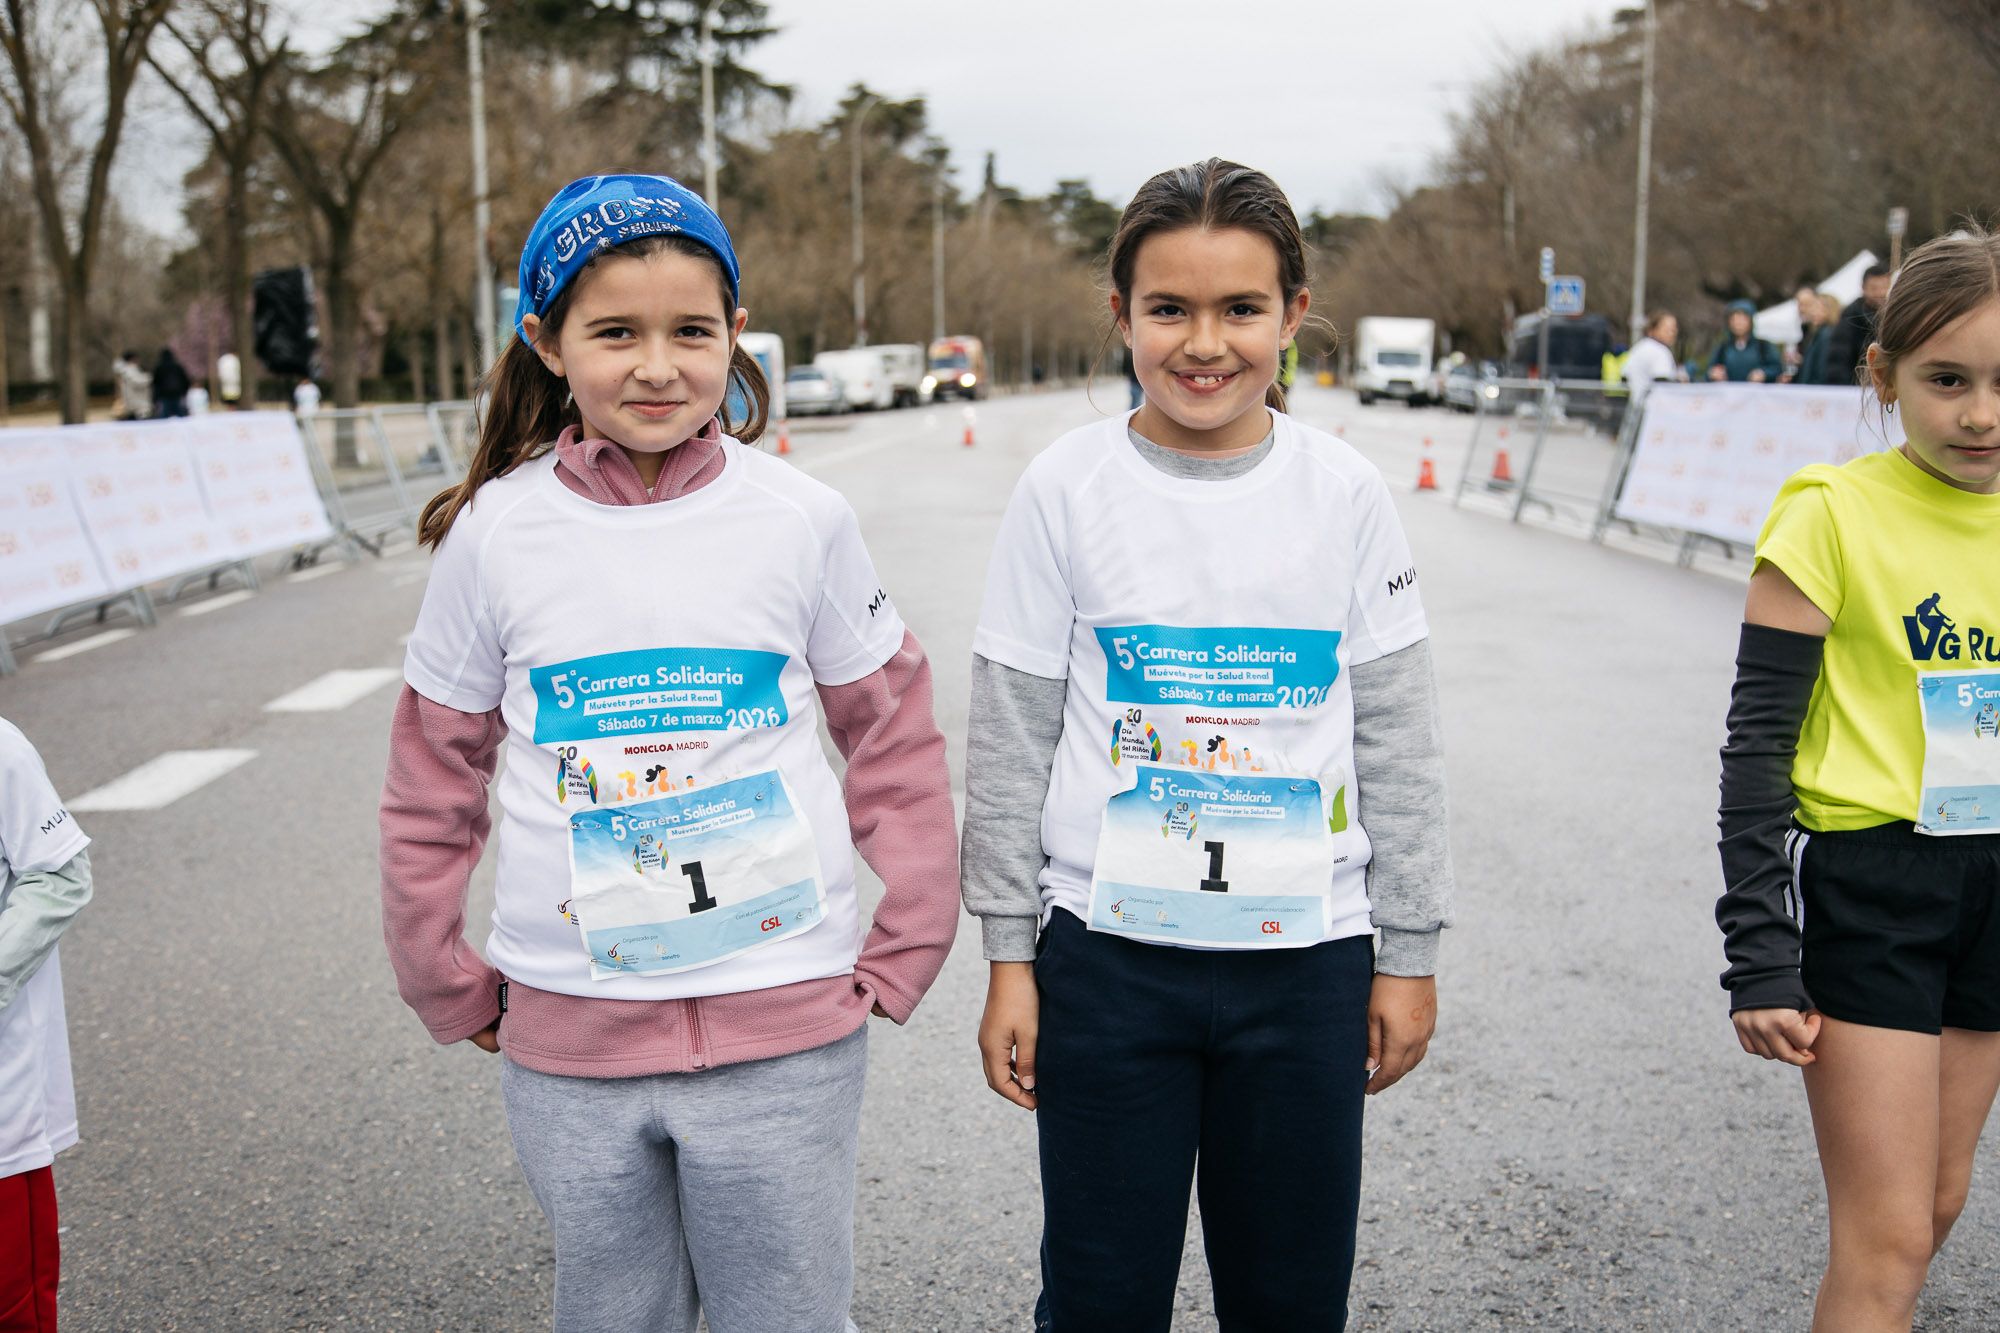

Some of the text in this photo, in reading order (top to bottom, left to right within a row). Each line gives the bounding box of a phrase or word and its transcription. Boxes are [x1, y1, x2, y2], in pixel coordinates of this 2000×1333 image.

[1136, 642, 1208, 664] Carrera
[1214, 645, 1296, 664] Solidaria
[577, 670, 650, 694] Carrera
[656, 666, 743, 686] Solidaria
[1148, 668, 1270, 681] Muévete por la Salud Renal
[588, 692, 718, 712] Muévete por la Salud Renal
[1158, 686, 1204, 702] Sábado
[1206, 690, 1213, 702] 7
[1217, 688, 1234, 702] de
[1236, 691, 1275, 702] marzo
[598, 706, 780, 732] Sábado 7 de marzo 2026
[1186, 716, 1260, 726] MONCLOA MADRID
[624, 741, 709, 756] MONCLOA MADRID
[1122, 736, 1145, 745] Mundial
[1168, 784, 1218, 802] Carrera
[1222, 788, 1272, 804] Solidaria
[628, 814, 680, 832] Carrera
[683, 798, 736, 820] Solidaria
[1200, 840, 1229, 893] 1
[680, 860, 718, 914] 1
[760, 916, 782, 932] CSL
[1262, 921, 1282, 934] CSL
